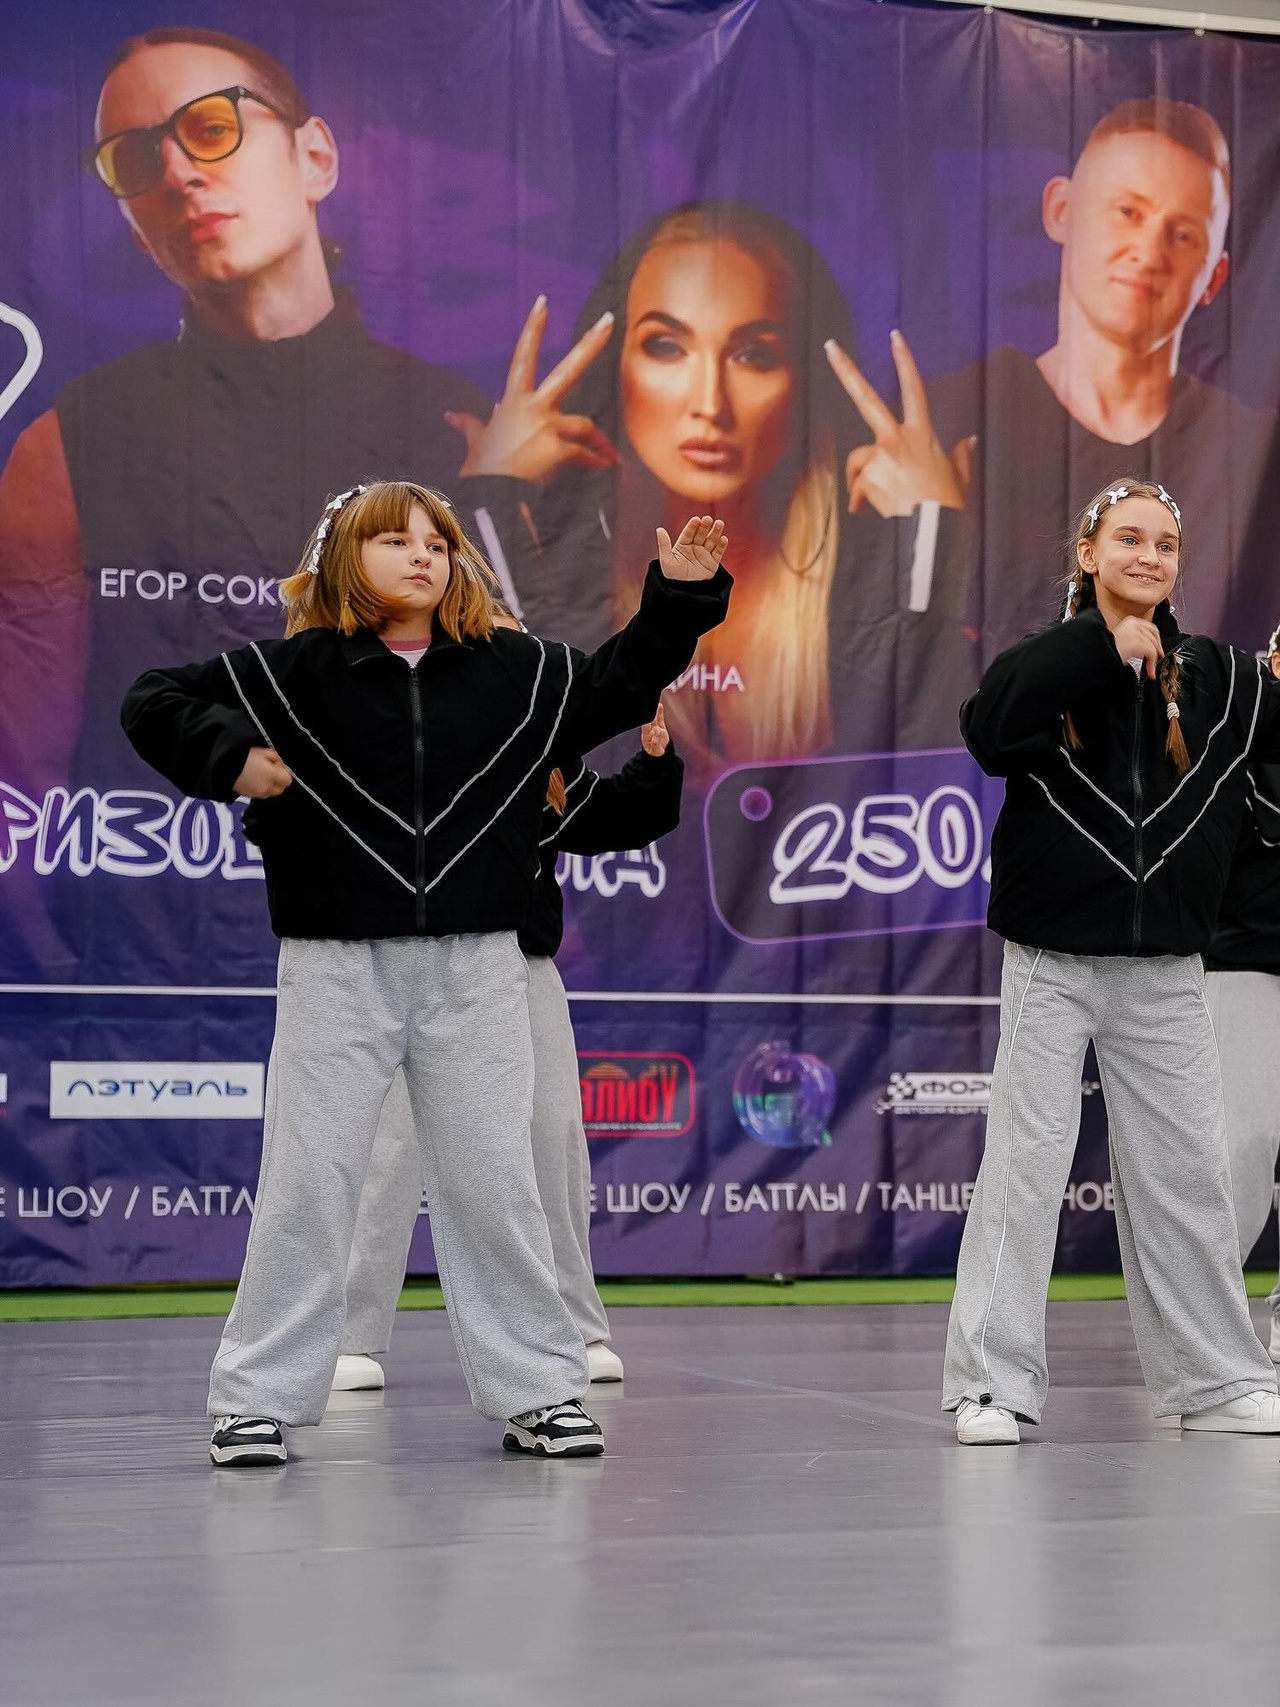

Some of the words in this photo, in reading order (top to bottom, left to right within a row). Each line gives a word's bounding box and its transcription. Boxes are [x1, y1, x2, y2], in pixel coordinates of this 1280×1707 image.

[100, 567, 188, 600] ЕГОР
[197, 573, 287, 607] СОК
[18, 1186, 113, 1218] ШОУ
[152, 1186, 255, 1217] БАТТЛ
[606, 1182, 692, 1213] ШОУ
[724, 1182, 847, 1213] БАТТЛЫ
